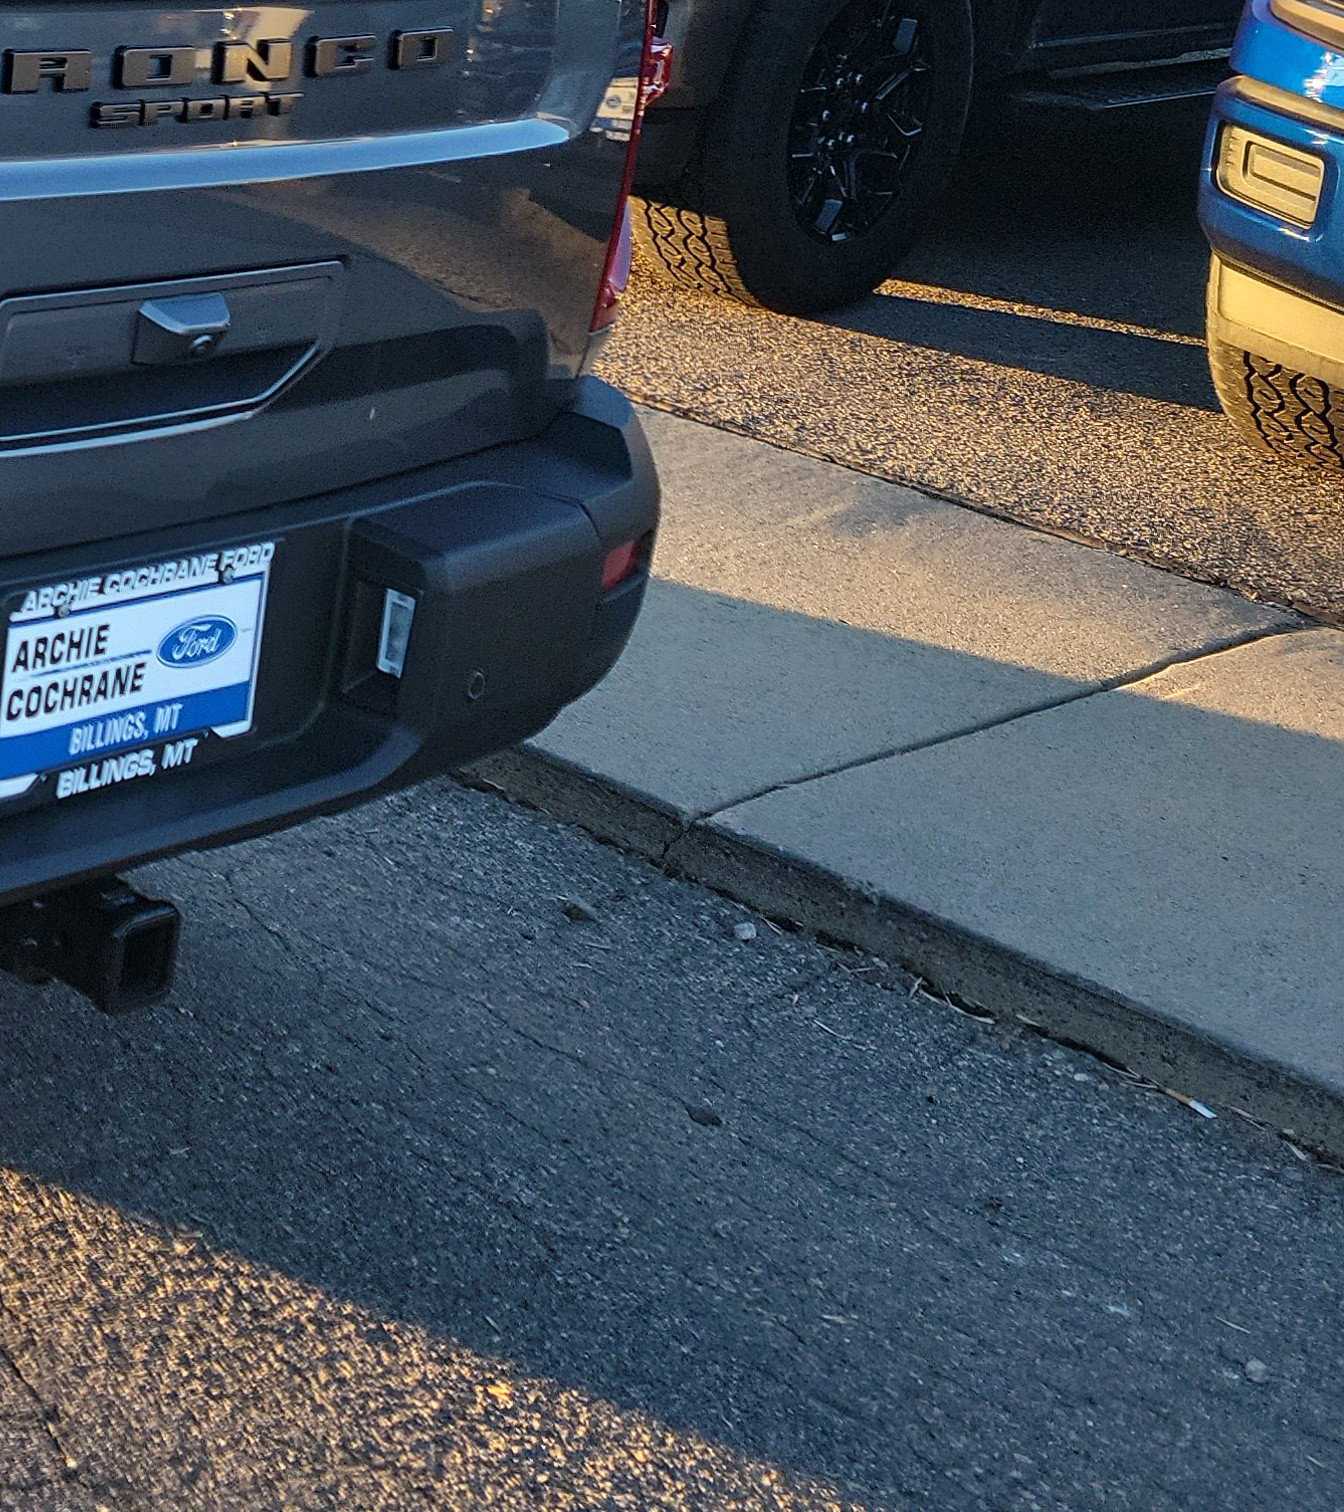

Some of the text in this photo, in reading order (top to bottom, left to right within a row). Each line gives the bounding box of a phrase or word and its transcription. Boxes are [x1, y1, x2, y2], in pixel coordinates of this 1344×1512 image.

[89, 91, 304, 129] SPORT
[12, 624, 110, 674] ARCHIE
[172, 623, 221, 662] Ford
[5, 661, 147, 722] COCHRANE
[68, 703, 183, 756] BILLINGS, MT
[55, 738, 199, 800] BILLINGS, MT
